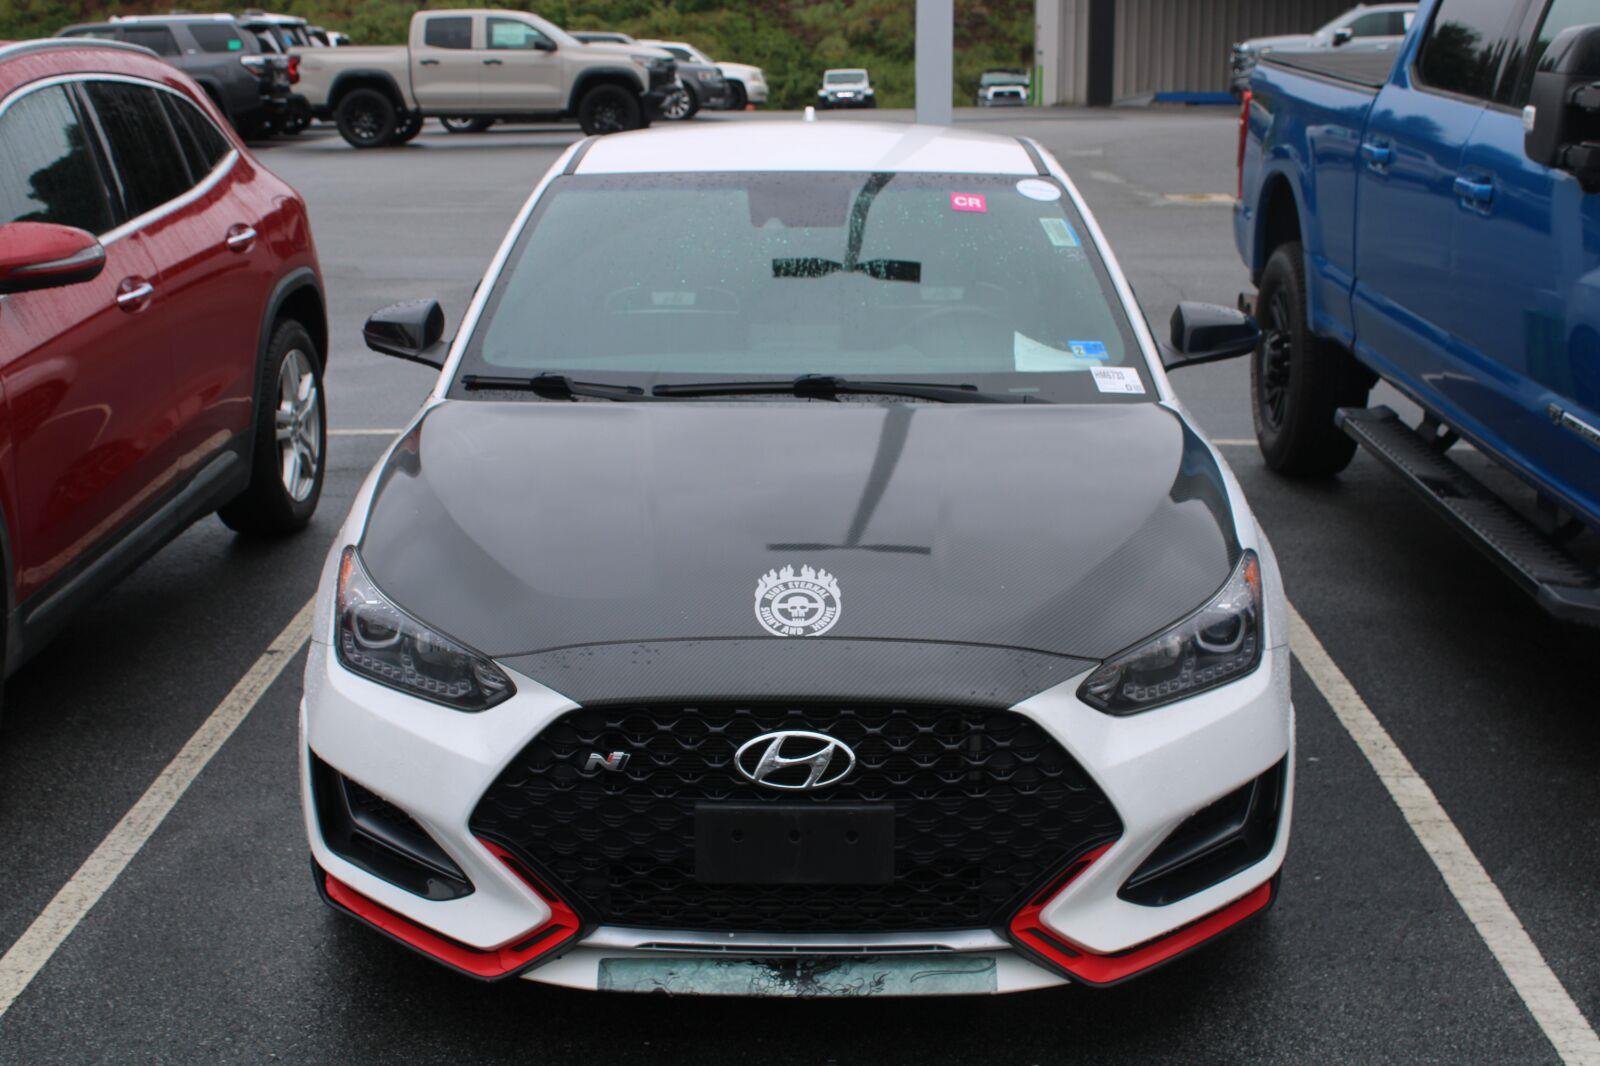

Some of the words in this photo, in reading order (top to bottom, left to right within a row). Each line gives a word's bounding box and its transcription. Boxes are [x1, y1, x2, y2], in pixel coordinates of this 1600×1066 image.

[954, 196, 982, 208] CR
[764, 584, 786, 600] RIDE
[760, 606, 782, 629] SHINY
[781, 626, 804, 636] AND
